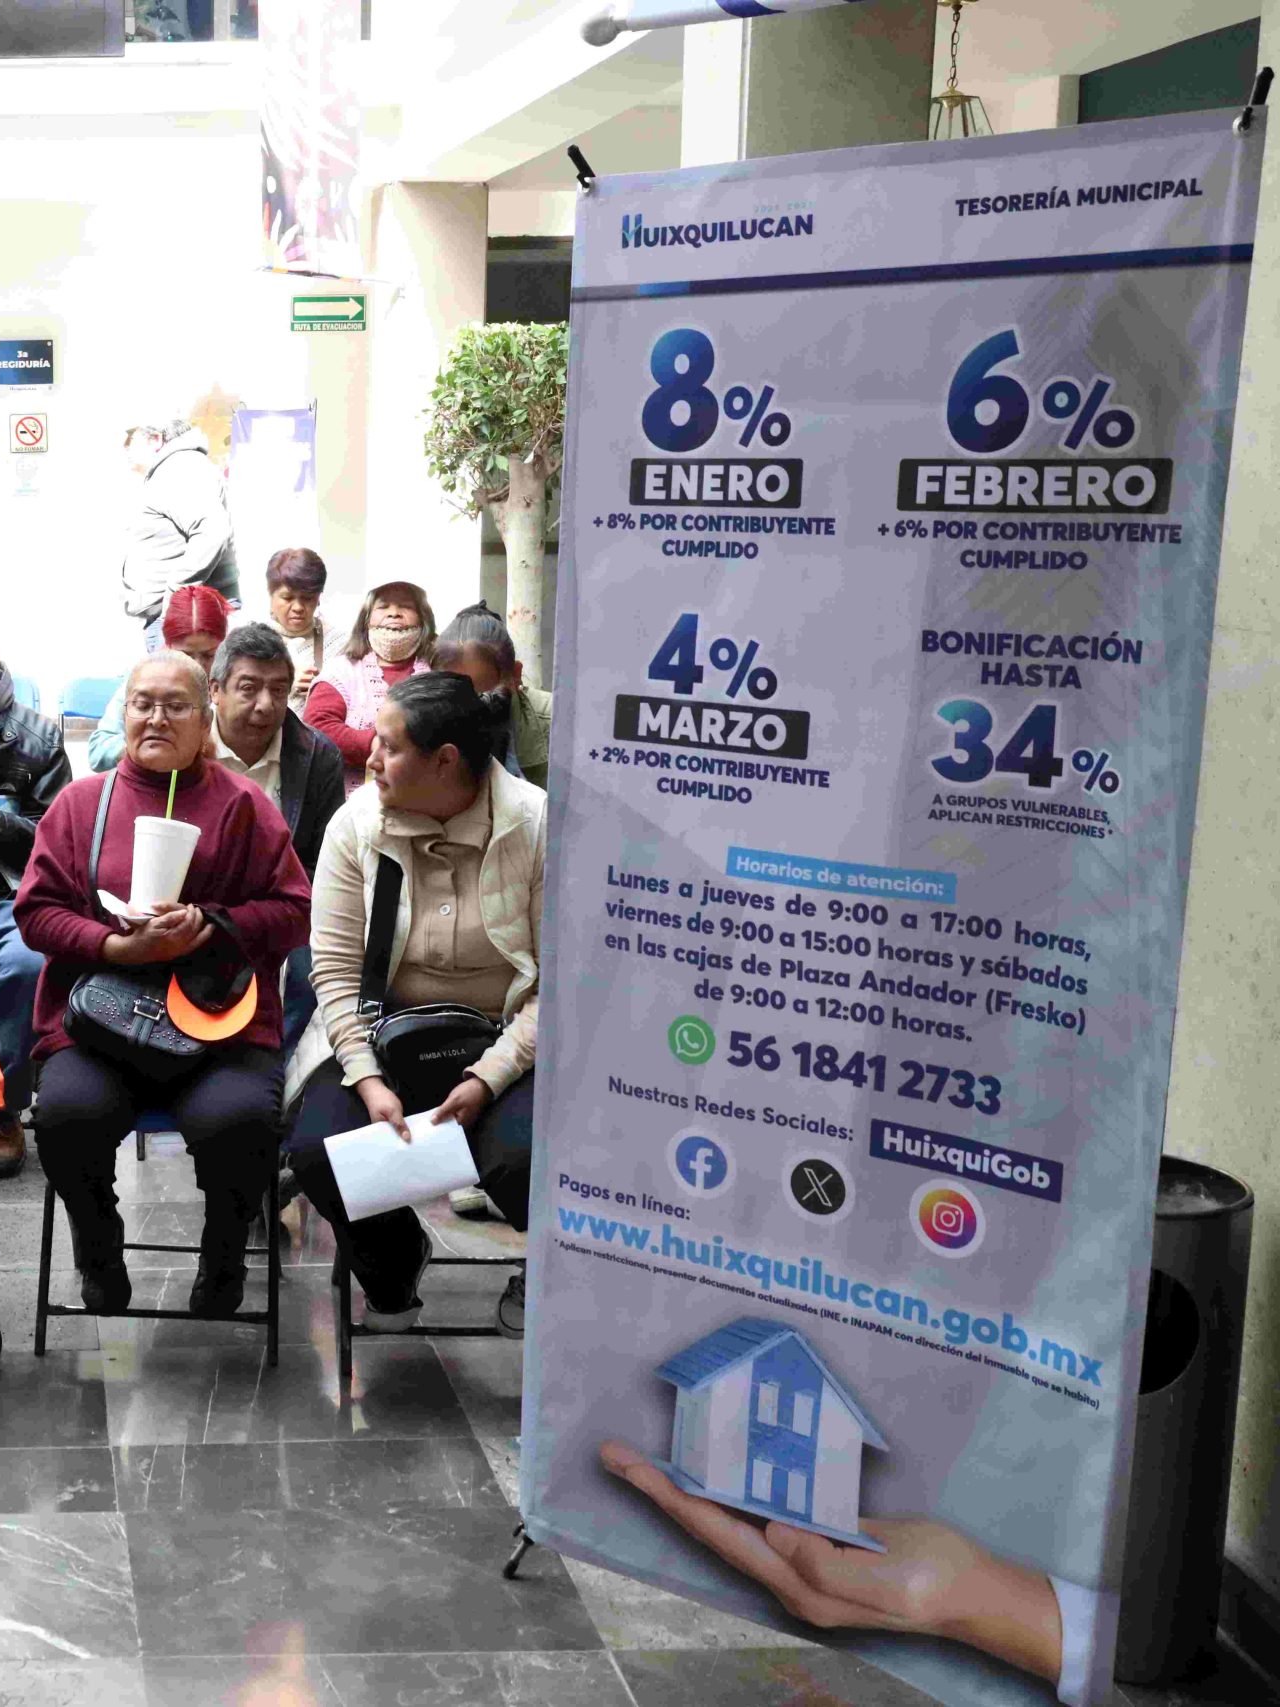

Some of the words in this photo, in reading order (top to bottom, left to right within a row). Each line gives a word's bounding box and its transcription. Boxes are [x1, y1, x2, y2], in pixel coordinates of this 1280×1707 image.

[956, 186, 1071, 216] TESORERÍA
[1077, 178, 1202, 206] MUNICIPAL
[622, 213, 813, 248] HUIXQUILUCAN
[641, 327, 792, 454] 8%
[946, 328, 1135, 455] 6%
[643, 466, 790, 502] ENERO
[916, 466, 1157, 507] FEBRERO
[607, 513, 636, 530] 8%
[640, 514, 677, 531] POR
[681, 514, 836, 535] CONTRIBUYENTE
[894, 520, 928, 538] 6%
[933, 520, 978, 540] POR
[982, 522, 1182, 544] CONTRIBUYENTE
[662, 540, 759, 559] CUMPLIDO
[960, 550, 1088, 570] CUMPLIDO
[648, 613, 778, 701] 4%
[921, 628, 1143, 664] BONIFICACIÓN
[981, 662, 1082, 690] HASTA
[637, 705, 787, 750] MARZO
[603, 747, 630, 764] 2%
[634, 750, 671, 769] POR
[675, 754, 830, 788] CONTRIBUYENTE
[657, 777, 752, 804] CUMPLIDO
[932, 794, 943, 805] A
[946, 794, 1008, 810] GRUPOS
[1011, 799, 1111, 825] VULNERABLES,
[928, 809, 993, 824] APLICAN
[996, 814, 1106, 839] RESTRICCIONES
[736, 855, 812, 881] Horarios
[816, 867, 841, 886] de
[847, 873, 944, 896] atención:
[607, 864, 670, 894] Lunes
[678, 881, 693, 898] a
[700, 880, 776, 911] jueves
[785, 894, 816, 917] de
[828, 899, 888, 926] 9:00
[900, 913, 918, 929] a
[930, 911, 1002, 940] 17:00
[1015, 920, 1092, 962] horas,
[606, 899, 682, 929] viernes
[686, 912, 714, 935] de
[720, 917, 774, 944] 9:00
[779, 932, 796, 948] a
[802, 930, 871, 957] 15:00
[878, 938, 954, 968] horas
[960, 954, 975, 977] y
[981, 955, 1088, 996] sábados
[605, 934, 630, 951] en
[637, 934, 667, 958] las
[673, 946, 734, 972] cajas
[741, 954, 772, 976] de
[780, 958, 850, 987] Plaza
[858, 970, 977, 1008] Andador
[985, 988, 1086, 1036] (Fresko)
[694, 979, 724, 1001] de
[730, 984, 786, 1010] 9:00
[792, 998, 808, 1015] a
[816, 998, 884, 1026] 12:00
[892, 1007, 972, 1042] horas.
[448, 1048, 466, 1056] LOLA
[727, 1030, 781, 1072] 56
[791, 1041, 886, 1093] 1841
[897, 1059, 1002, 1115] 2733
[608, 1076, 688, 1110] Nuestras
[694, 1095, 756, 1122] Redes
[762, 1108, 854, 1142] Sociales:
[882, 1127, 1051, 1190] HuixquiGob
[559, 1174, 610, 1200] Pagos
[615, 1192, 636, 1207] en
[642, 1193, 691, 1220] línea:
[558, 1207, 1104, 1387] www.huixquilucan.gob.mx
[559, 1240, 592, 1257] Aplican
[594, 1247, 652, 1272] restricciones,
[653, 1265, 697, 1283] presentar
[699, 1275, 756, 1298] documentos
[758, 1290, 818, 1316] actualizados
[820, 1308, 840, 1322] (INE
[842, 1316, 849, 1324] e
[850, 1318, 893, 1338] INAPAM
[894, 1330, 914, 1344] con
[915, 1335, 963, 1358] dirección
[966, 1348, 982, 1364] del
[984, 1355, 1030, 1380] inmueble
[1031, 1374, 1050, 1390] que
[1051, 1383, 1062, 1395] se
[1064, 1386, 1100, 1410] habita)
